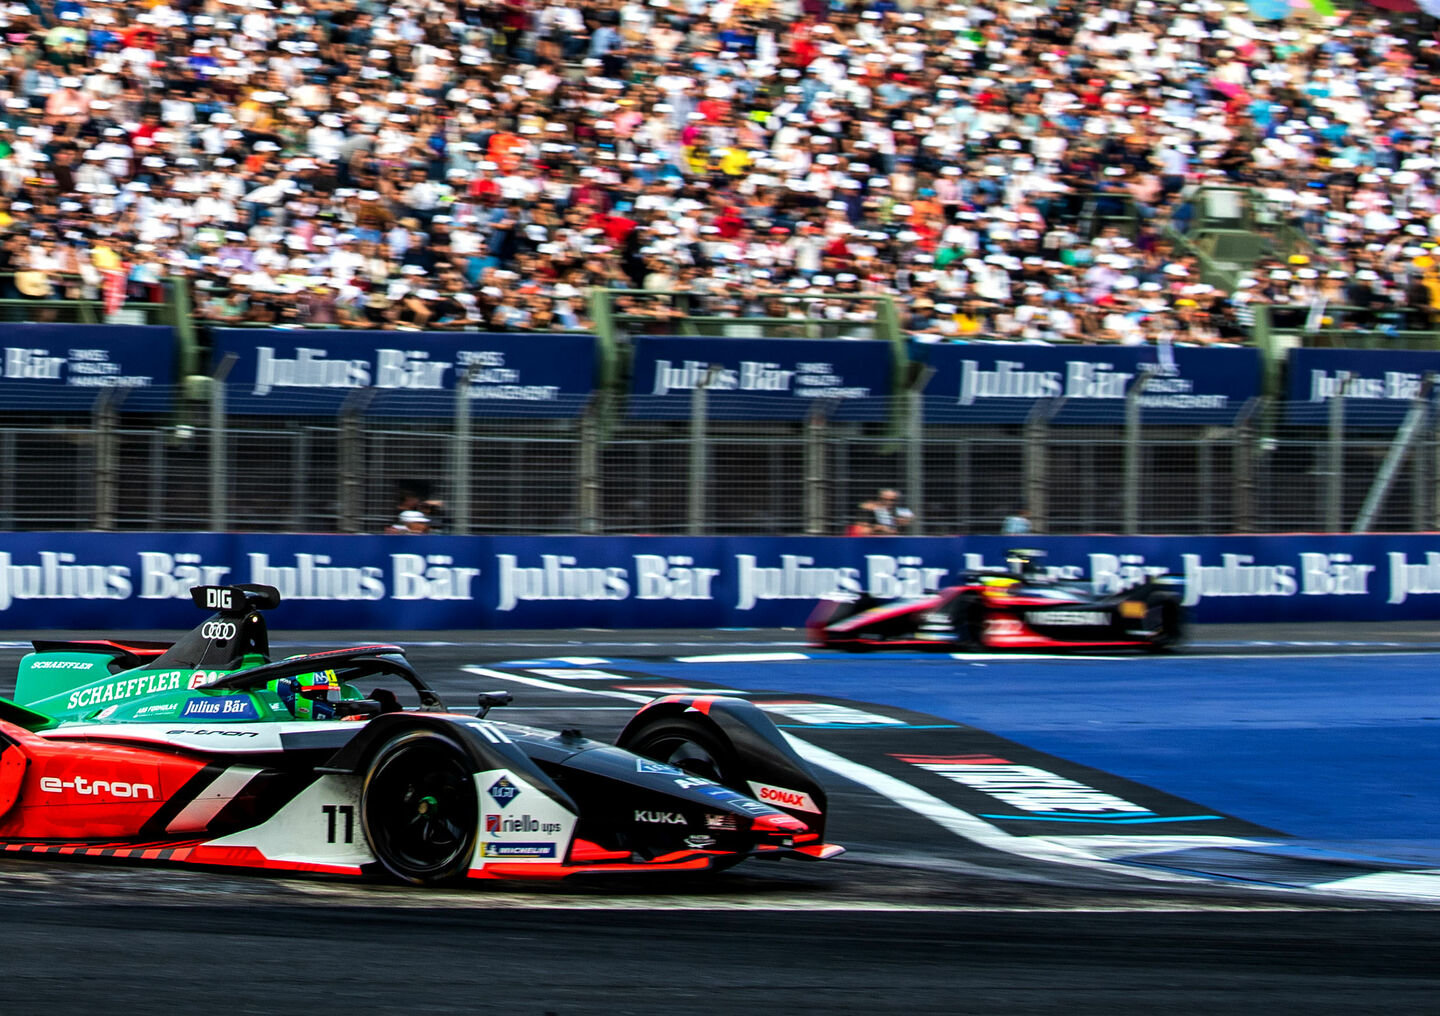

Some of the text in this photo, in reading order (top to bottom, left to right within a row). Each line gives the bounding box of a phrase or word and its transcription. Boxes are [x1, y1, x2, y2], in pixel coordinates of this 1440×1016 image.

[3, 347, 67, 379] Bär
[252, 346, 452, 396] Julius Bär
[652, 360, 796, 395] Julius Bär
[958, 360, 1135, 405] Julius Bär
[1310, 369, 1386, 403] Julius
[137, 552, 231, 599] Bär
[247, 553, 480, 600] Julius Bär
[496, 554, 720, 611] Julius Bär
[735, 554, 861, 610] Julius
[864, 555, 949, 599] Bär
[1181, 552, 1375, 606] Julius Bär
[207, 588, 232, 609] DIG
[31, 661, 93, 670] SCHAEFFLER
[67, 671, 181, 710] SCHAEFFLER
[184, 699, 248, 716] Julius Bär
[166, 729, 259, 738] e-tron
[466, 722, 512, 744] 11
[40, 776, 154, 799] e-tron
[760, 787, 804, 807] SONAX
[322, 805, 354, 844] 11
[503, 814, 562, 835] riello ups
[634, 810, 688, 825] KUKA
